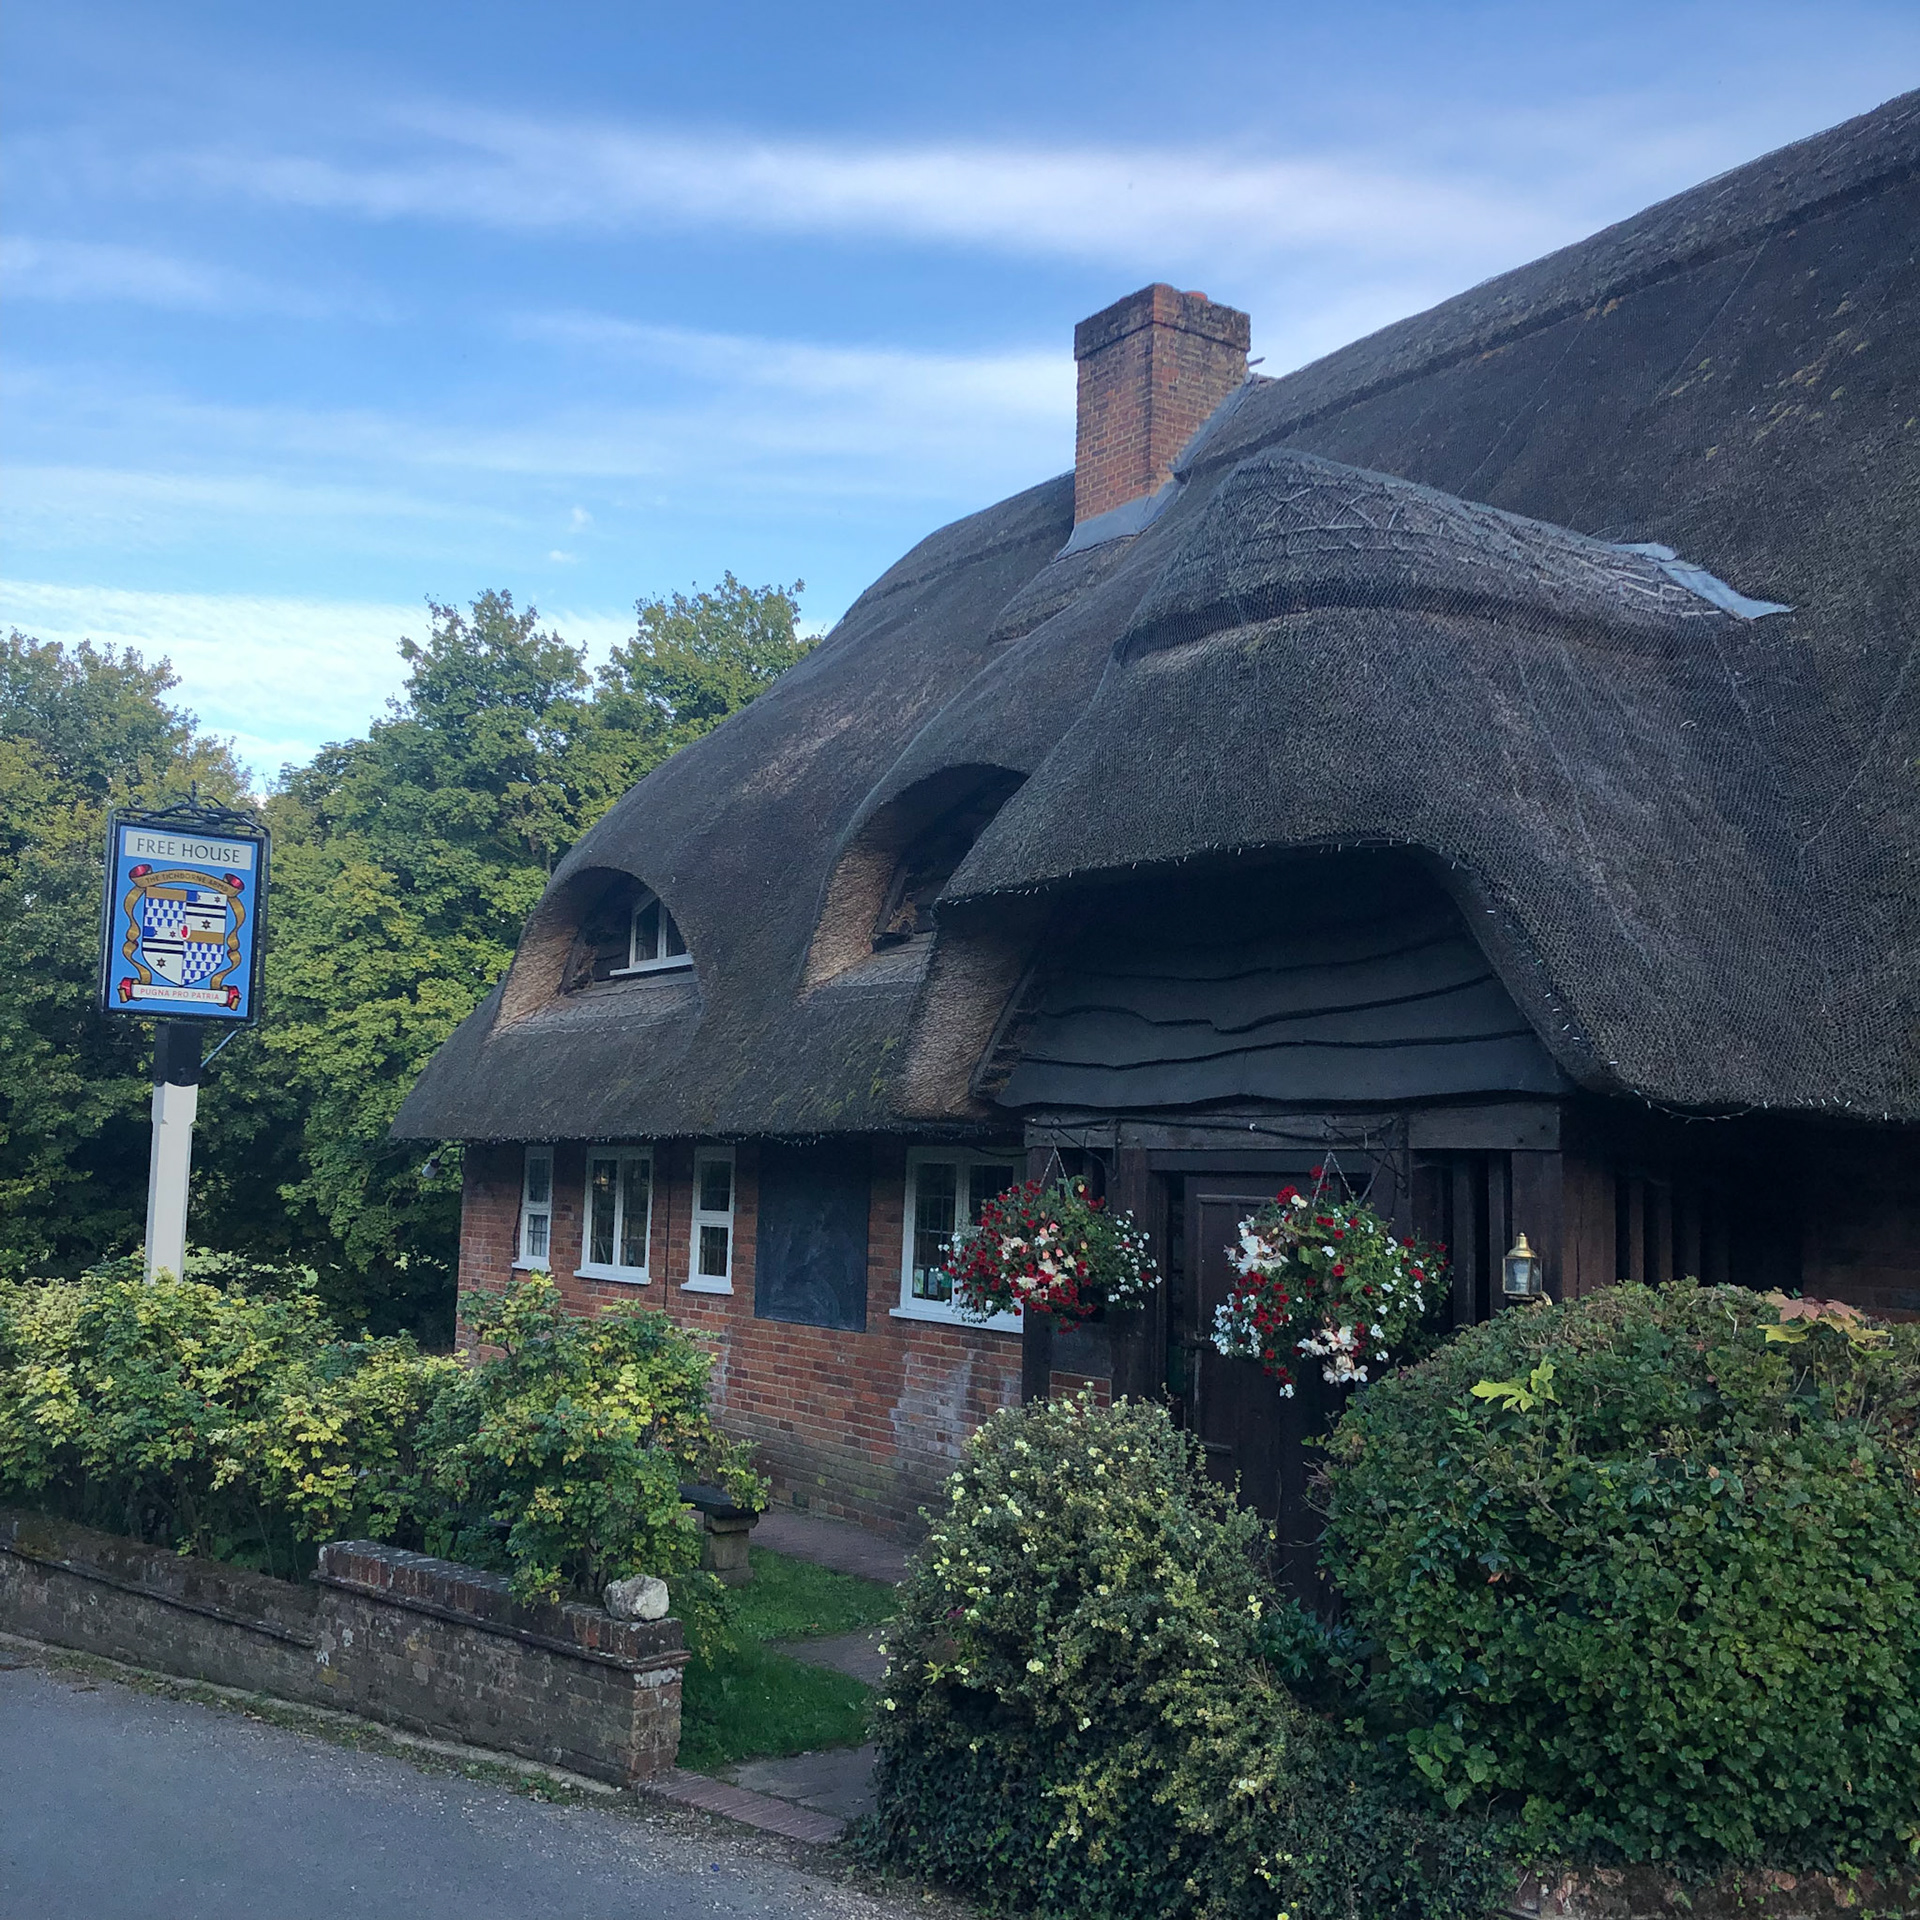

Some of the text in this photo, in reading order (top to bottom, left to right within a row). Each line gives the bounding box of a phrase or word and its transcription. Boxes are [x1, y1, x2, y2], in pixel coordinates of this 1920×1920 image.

[137, 838, 240, 863] FREE HOUSE
[145, 875, 159, 884] THE
[140, 988, 220, 1000] PUGNA PRO PATRIA
